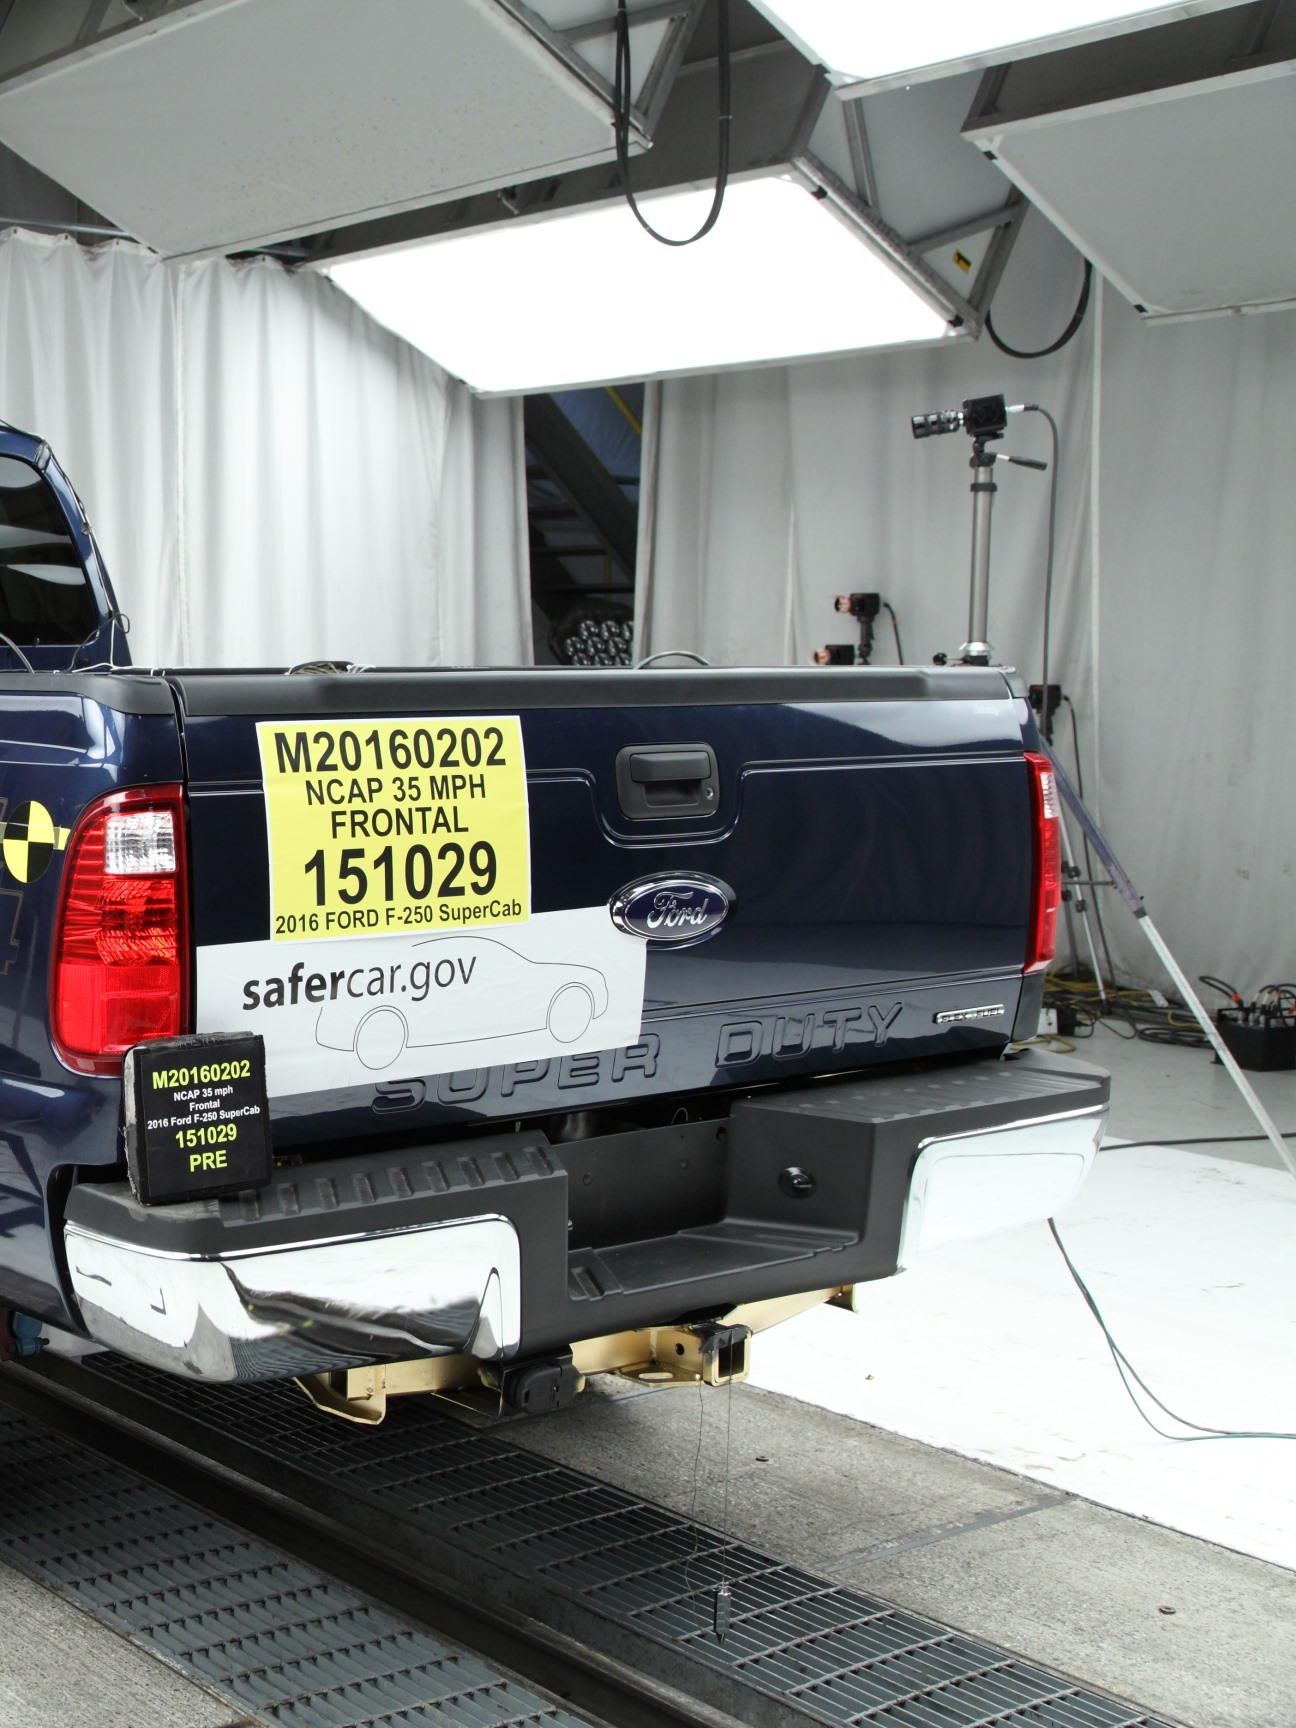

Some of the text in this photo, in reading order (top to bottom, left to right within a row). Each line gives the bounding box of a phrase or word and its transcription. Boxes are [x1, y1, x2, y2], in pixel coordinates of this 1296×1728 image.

[273, 726, 507, 774] M20160202
[305, 773, 486, 805] NCAP 35 MPH
[330, 805, 469, 839] FRONTAL
[304, 840, 497, 906] 151029
[275, 898, 522, 933] 2016 FORD F-250 SuperCab
[646, 891, 710, 929] Ford
[242, 956, 478, 1011] safercar.gov
[152, 1059, 251, 1089] M20160202
[372, 1001, 903, 1115] SUPER DUTY
[173, 1085, 234, 1101] NCAP 35 mph
[189, 1099, 220, 1112] Frontal
[147, 1105, 261, 1130] 2016 Ford F-250 SuperCab
[175, 1123, 237, 1148] 151029
[189, 1149, 228, 1172] PRE
